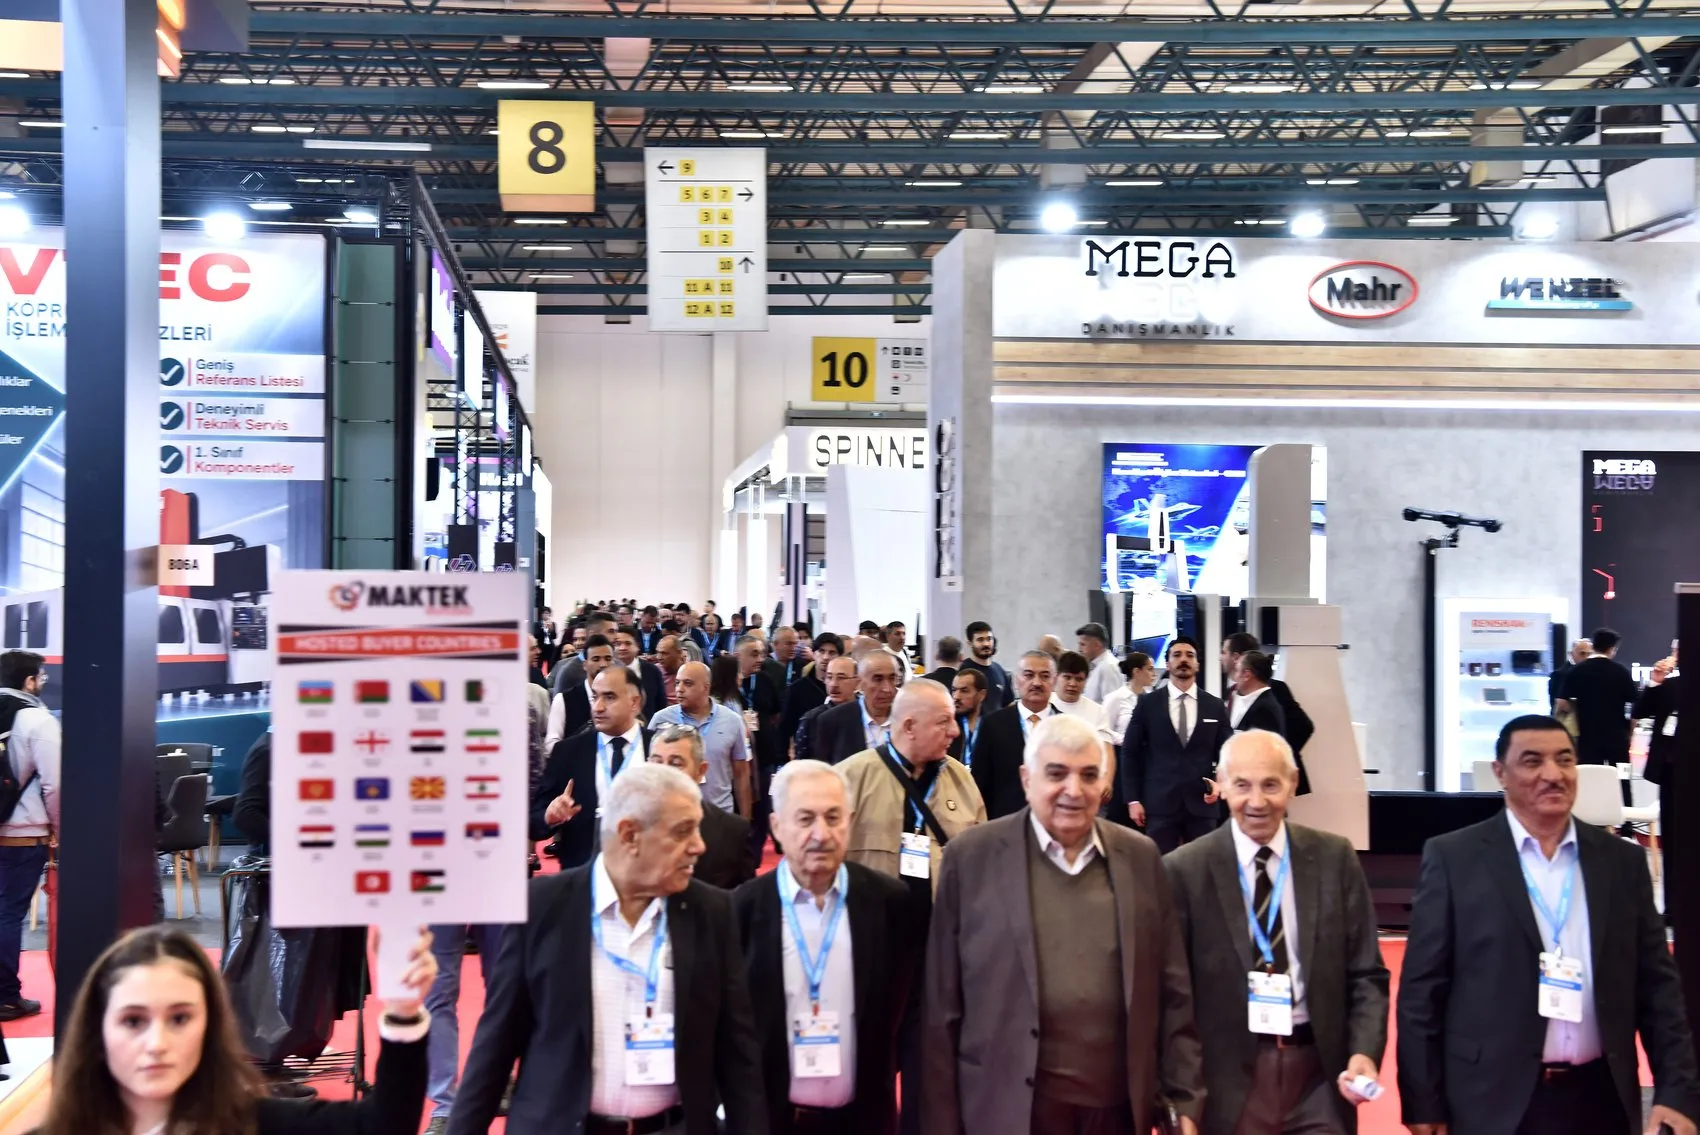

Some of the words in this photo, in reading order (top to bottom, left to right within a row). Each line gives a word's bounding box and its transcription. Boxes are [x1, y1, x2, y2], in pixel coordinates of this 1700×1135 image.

[528, 121, 566, 174] 8
[683, 162, 692, 173] 9
[684, 189, 692, 200] 5
[702, 189, 711, 200] 6
[721, 189, 729, 200] 7
[703, 211, 711, 222] 3
[721, 211, 729, 222] 4
[704, 233, 711, 244] 1
[721, 233, 730, 244] 2
[720, 260, 733, 271] 10
[1085, 240, 1236, 278] MEGA
[686, 283, 699, 292] 11
[704, 283, 712, 292] A
[720, 283, 733, 292] 11
[1327, 276, 1402, 301] Mahr
[686, 304, 699, 314] 12
[704, 304, 713, 314] A
[720, 304, 733, 314] 12
[1081, 322, 1236, 337] DANIŞMANLIK
[195, 358, 235, 373] Geniş
[820, 352, 869, 388] 10
[195, 373, 257, 386] Referans
[260, 375, 304, 387] Listesi
[195, 402, 265, 417] Deneyimli
[195, 418, 241, 430] Teknik
[245, 419, 289, 431] Servis
[195, 446, 207, 458] 1.
[211, 446, 244, 458] Sınıf
[816, 434, 925, 469] SPINNE
[195, 461, 295, 475] Komponentler
[1592, 459, 1657, 475] MEGA
[367, 585, 468, 607] MAKTEK
[294, 635, 358, 651] HOSTED
[361, 635, 413, 651] BUYER
[416, 635, 502, 651] COUNTRIES
